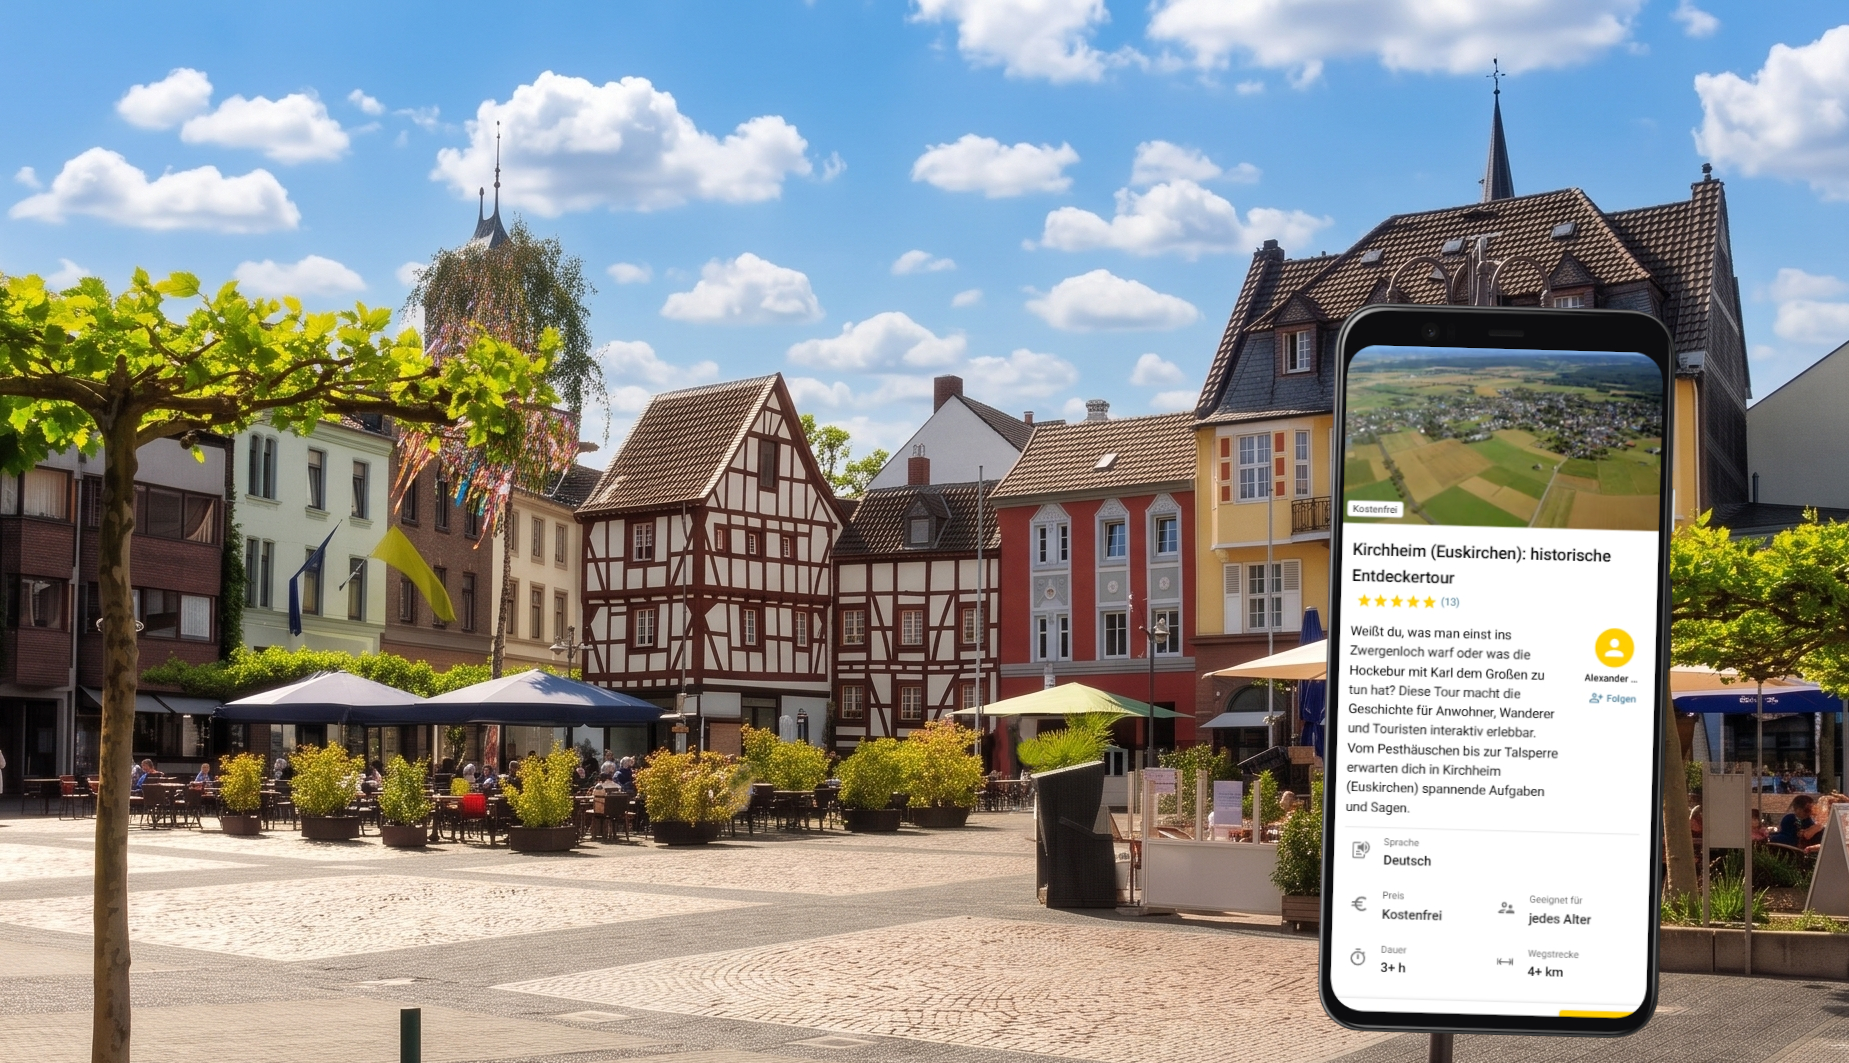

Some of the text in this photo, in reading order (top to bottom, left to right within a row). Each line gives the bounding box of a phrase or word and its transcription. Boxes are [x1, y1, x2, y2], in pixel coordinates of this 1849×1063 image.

[1353, 504, 1398, 515] Kostenfrei
[1352, 542, 1612, 564] Kirchheim (Euskirchen): historische
[1352, 568, 1456, 585] Entdeckertour
[1440, 596, 1460, 608] (13)
[1350, 625, 1512, 641] Weißt du, was man einst ins
[1349, 644, 1531, 661] Zwergenloch warf oder was die
[1349, 664, 1545, 681] Hockebur mit Karl dem Großen zu
[1584, 673, 1629, 683] Alexander
[1348, 684, 1521, 700] tun hat? Diese Tour macht die
[1606, 694, 1637, 705] Folgen
[1348, 702, 1555, 720] Geschichte für Anwohner, Wanderer
[1347, 722, 1536, 739] und Touristen interaktiv erlebbar.
[1347, 742, 1559, 761] Vom Pesthäuschen bis zur Talsperre
[1346, 762, 1502, 777] erwarten dich in Kirchheim
[1346, 779, 1545, 799] (Euskirchen) spannende Aufgaben
[1345, 801, 1410, 816] und Sagen.
[1383, 837, 1420, 848] Sprache
[1383, 854, 1432, 867] Deutsch
[1382, 890, 1405, 900] Preis
[1529, 894, 1582, 905] Geeignet für
[1381, 908, 1443, 921] Kostenfrei
[1527, 912, 1592, 927] jedes Alter
[1381, 945, 1407, 954] Dauer
[1528, 949, 1579, 960] Wegstrecke
[1380, 961, 1406, 974] 3+ h
[1527, 965, 1564, 978] 4+ km
